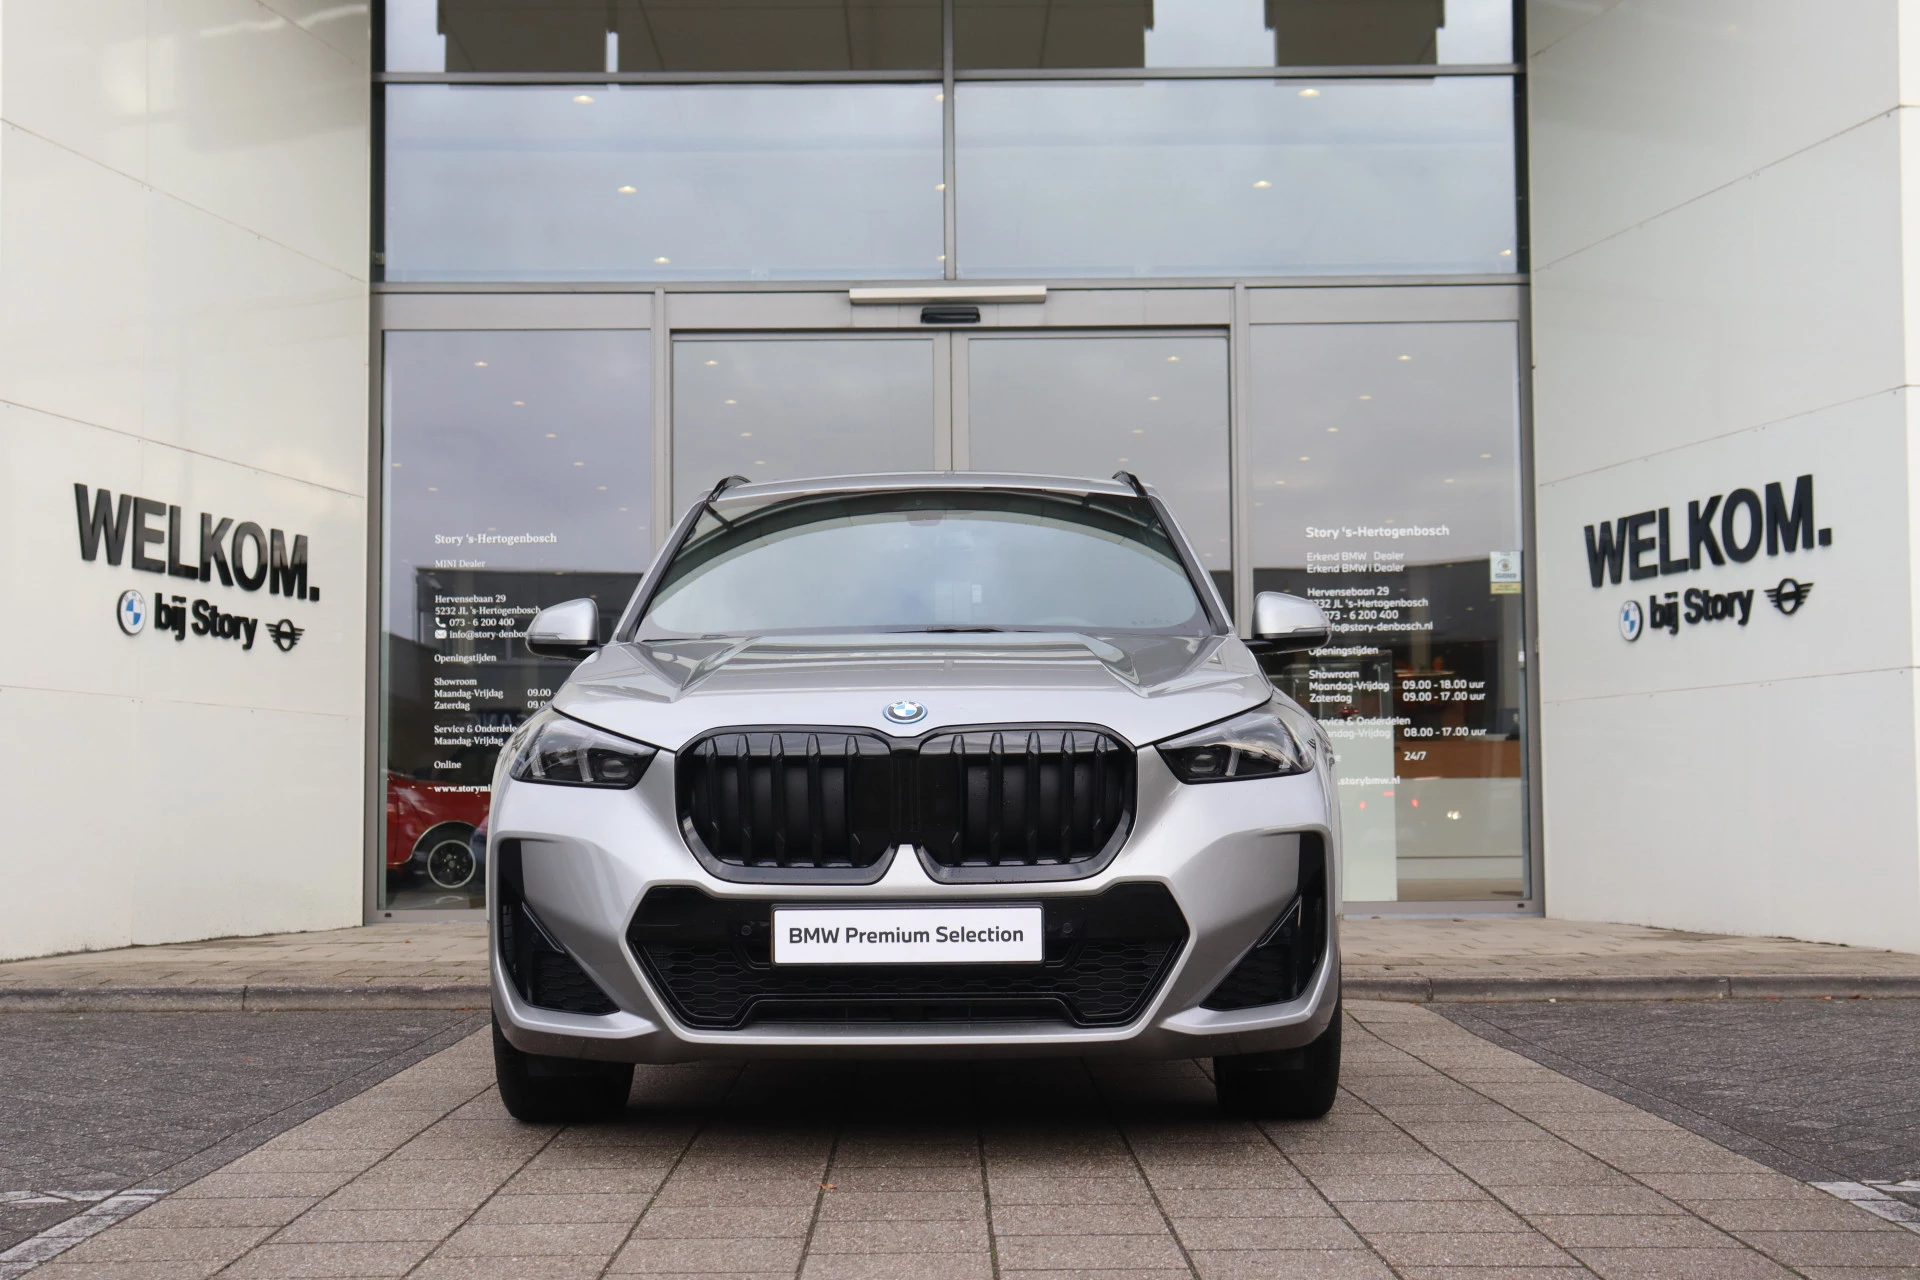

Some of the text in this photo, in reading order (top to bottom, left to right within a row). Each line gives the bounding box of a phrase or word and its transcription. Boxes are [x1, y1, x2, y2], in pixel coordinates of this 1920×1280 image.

[1305, 524, 1450, 540] Story 's-Hertogenbosch
[1584, 474, 1832, 588] WELKOM.
[74, 483, 320, 602] WELKOM.
[435, 534, 463, 546] Story
[1306, 551, 1404, 562] Erkend BMW Dealer
[435, 560, 486, 568] MINI Dealer
[1306, 563, 1405, 574] Erkend BMW i Dealer
[1307, 586, 1390, 597] Hervensebaan 29
[434, 595, 506, 604] Hervensebaan 29
[1332, 599, 1344, 609] JL
[434, 606, 456, 615] 5232
[457, 606, 469, 616] JL
[1684, 588, 1754, 626] Story
[1349, 610, 1356, 620] 6
[1357, 610, 1377, 620] 200
[1378, 610, 1399, 619] 400
[191, 599, 258, 651] Story
[449, 618, 466, 627] 073
[472, 618, 479, 627] 6
[480, 618, 497, 627] 200
[498, 618, 515, 627] 400
[1331, 621, 1433, 633] fo@story-denbosch.nl
[449, 629, 528, 640] info@story-denbos
[1308, 646, 1379, 656] Openingstijden
[434, 653, 497, 664] Openingstijden
[1309, 670, 1360, 680] Showroom
[434, 677, 477, 686] Showroom
[1309, 681, 1390, 692] Maandag-Vrijdag
[1402, 680, 1432, 690] 09.00
[1440, 679, 1467, 689] 18.00
[1468, 681, 1486, 689] uur
[434, 689, 504, 699] Maandag-Vrijdag
[527, 688, 551, 697] 09.00
[1309, 693, 1352, 704] Zaterdag
[1402, 691, 1432, 701] 09.00
[434, 700, 546, 711] Zaterdag 09.0
[1316, 716, 1411, 725] ervice & Onderdelen
[434, 724, 517, 733] Service & Onderdele
[1327, 728, 1391, 739] andag-Vrijdag
[1403, 728, 1433, 737] 08.00
[434, 737, 503, 747] Maandag-Vrijdag
[1404, 751, 1427, 761] 24/7
[434, 760, 462, 769] Online
[1337, 776, 1401, 787] .storybmw.nl
[434, 784, 491, 794] www.storymi
[789, 926, 1024, 944] BMW Premium Selection
